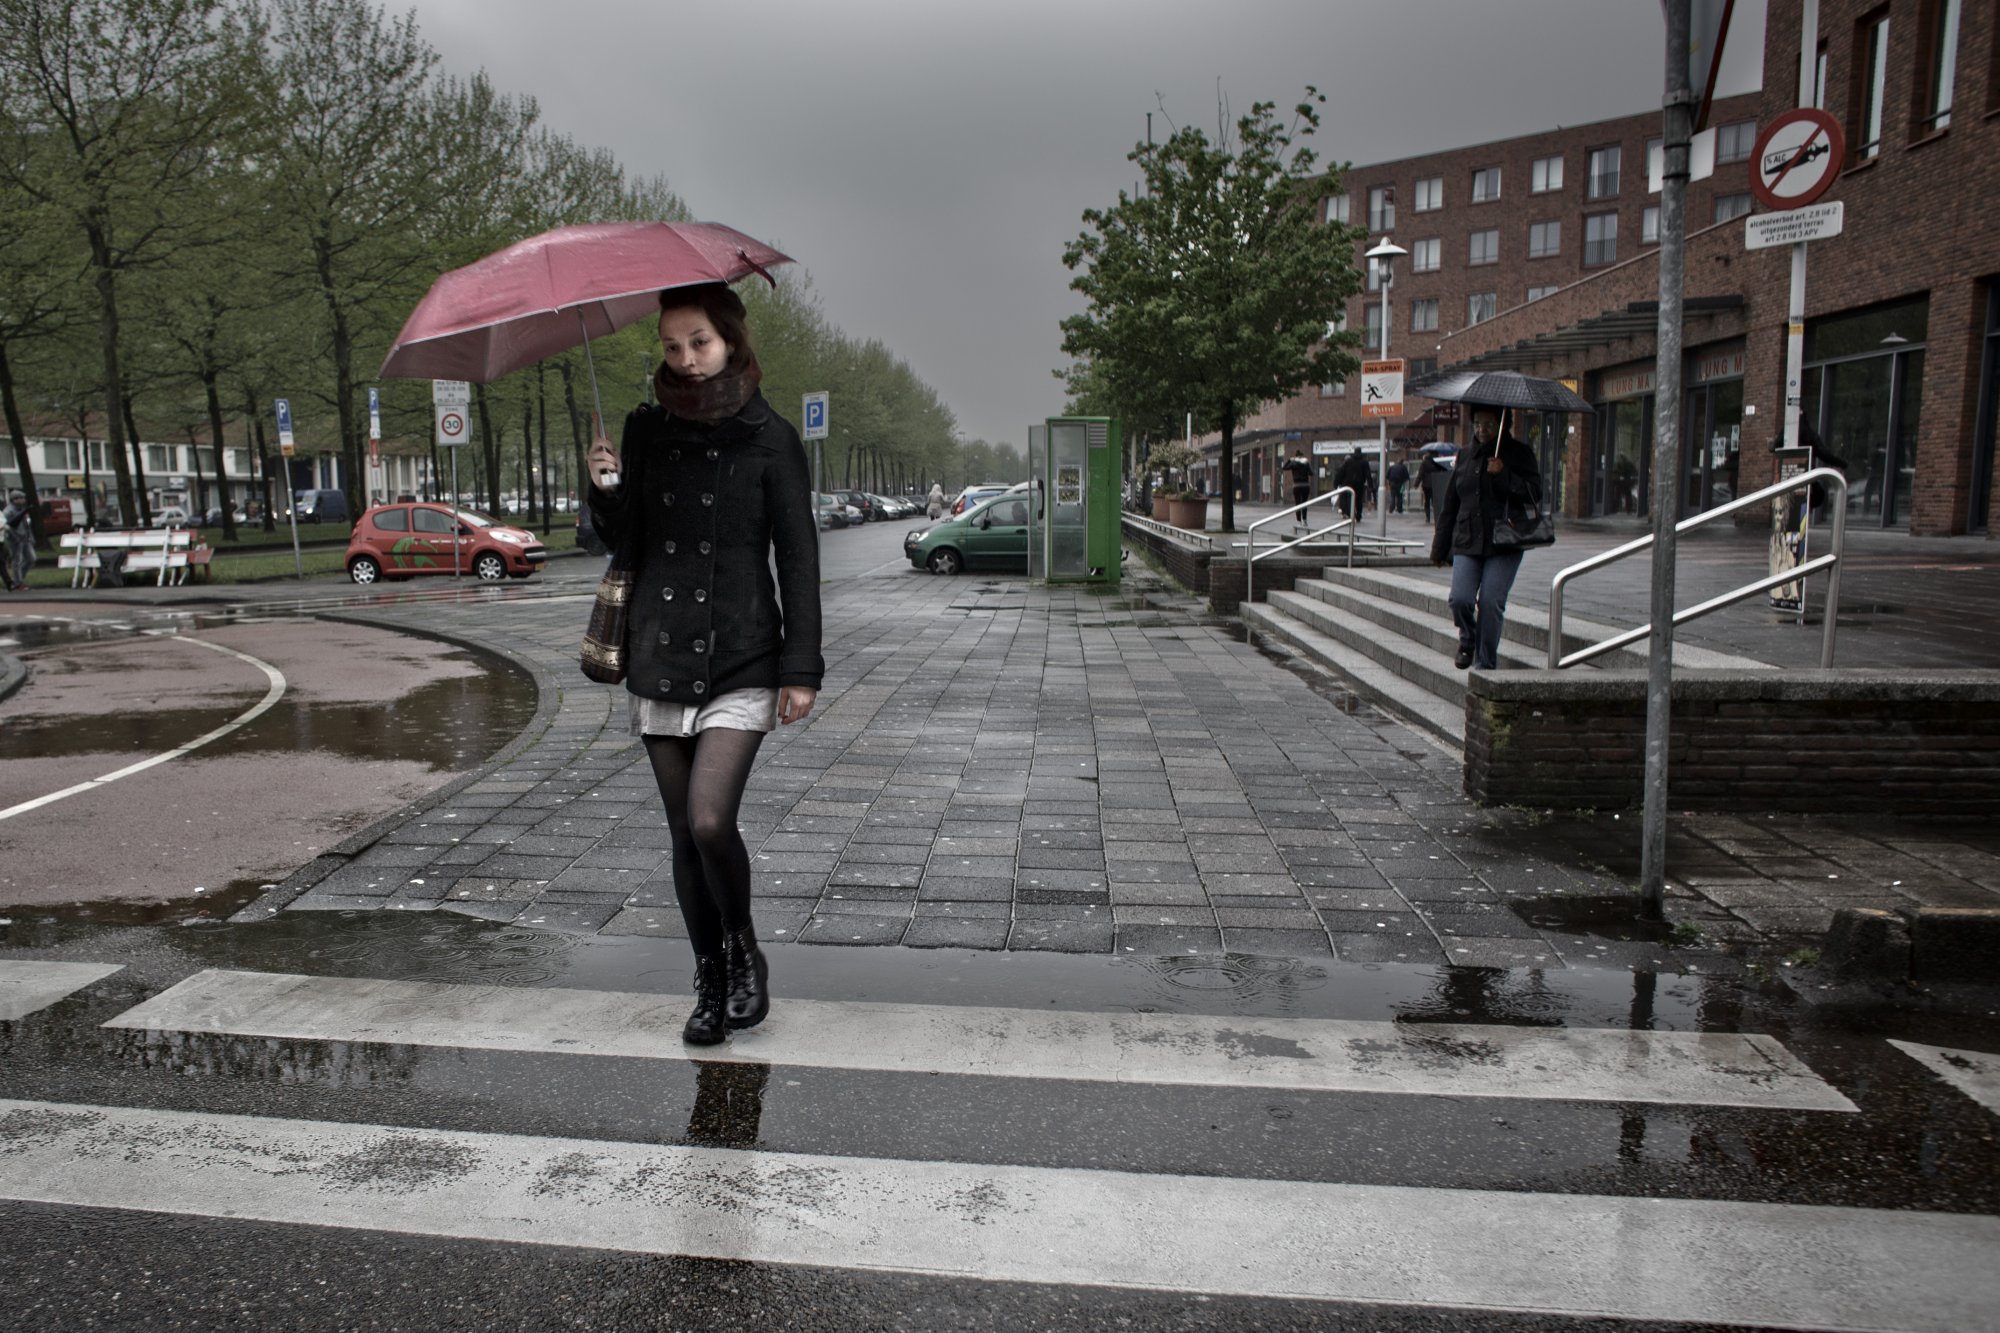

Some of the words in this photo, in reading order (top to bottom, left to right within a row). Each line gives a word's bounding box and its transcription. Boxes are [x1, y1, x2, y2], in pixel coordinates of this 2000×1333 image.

[1773, 153, 1786, 164] ALC
[1750, 215, 1794, 228] alcoholverbod
[1809, 209, 1821, 219] 2.8
[1822, 208, 1831, 217] lid
[1760, 222, 1803, 235] uitgezonderd
[1803, 219, 1824, 228] terras
[1776, 232, 1787, 241] 2.8
[1788, 231, 1797, 239] lid
[1804, 228, 1819, 237] APV
[1364, 366, 1400, 374] DNA-SPRAY
[1698, 358, 1728, 377] LUNG
[1638, 374, 1650, 390] MA
[278, 402, 287, 419] P
[809, 404, 820, 425] P
[445, 420, 460, 429] 30
